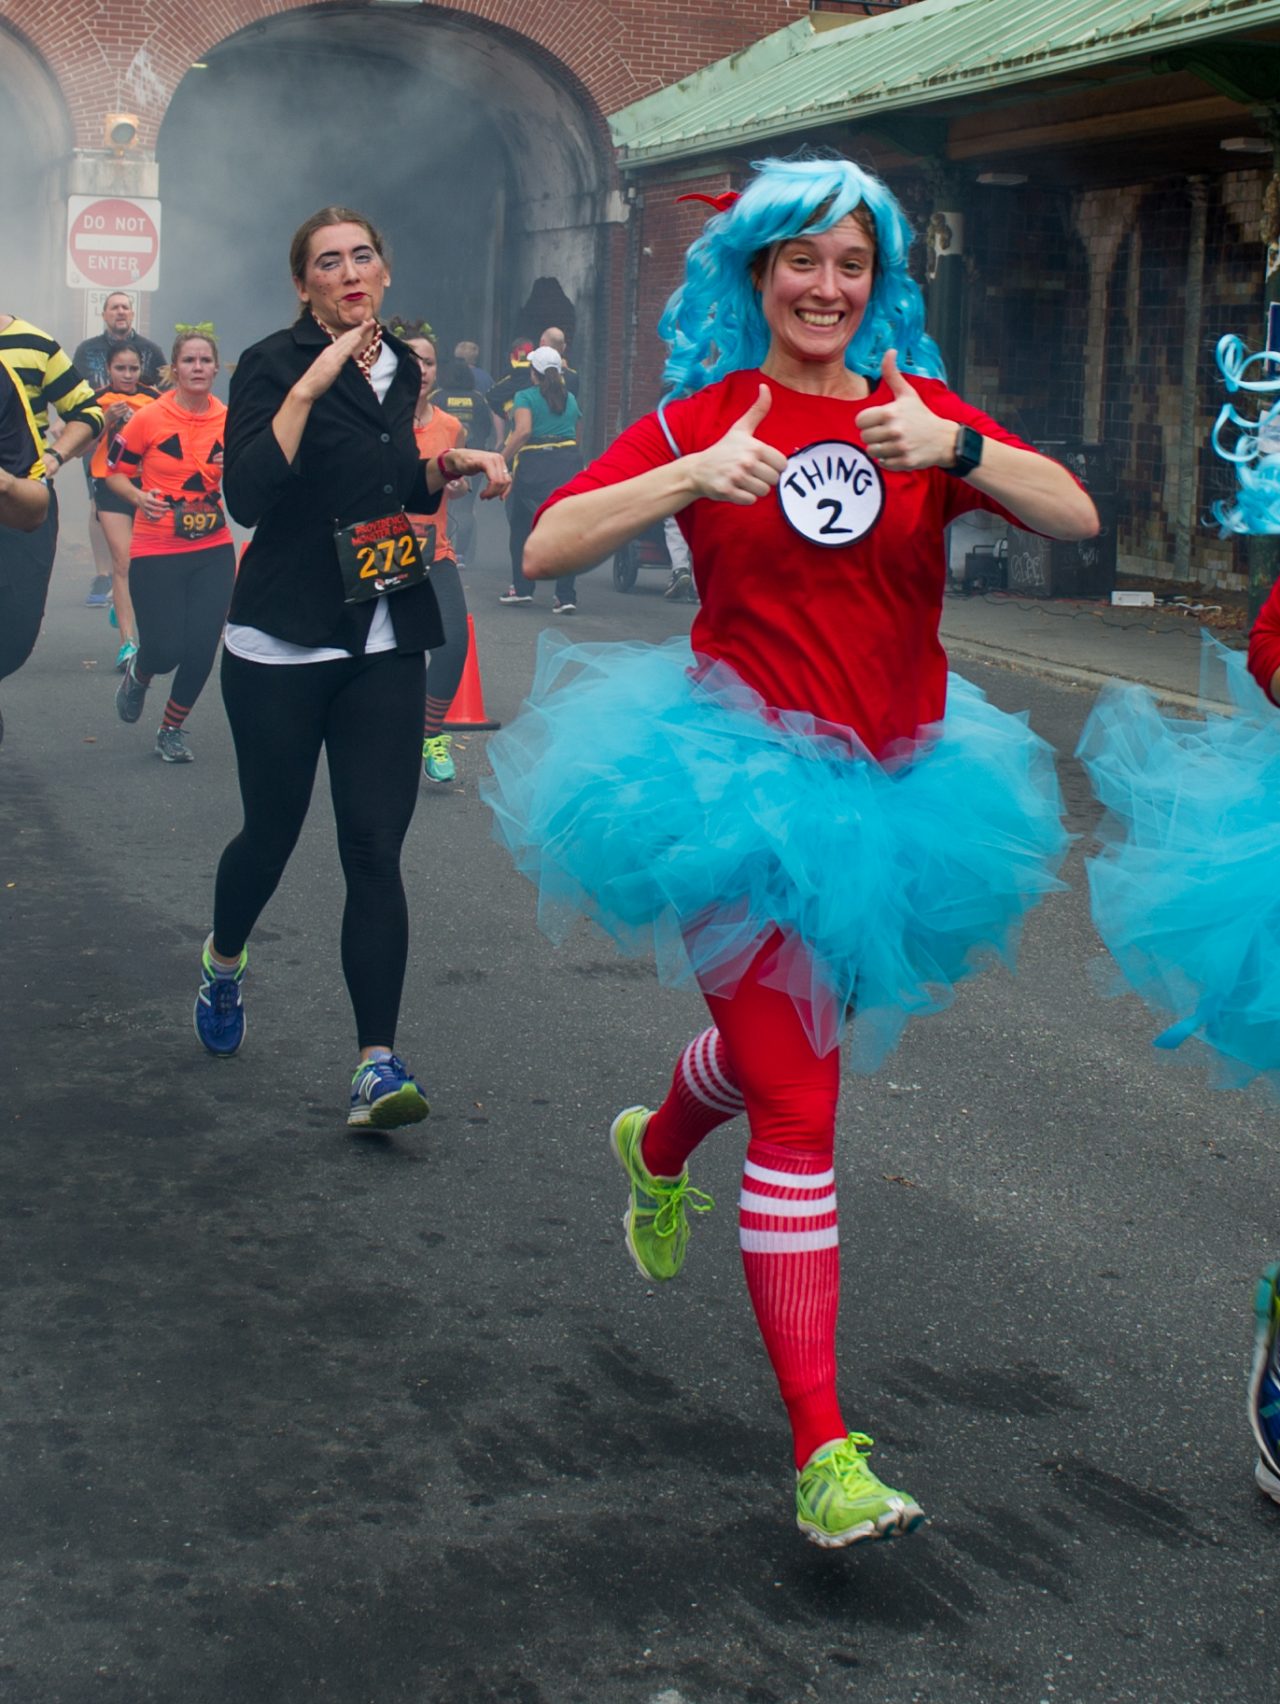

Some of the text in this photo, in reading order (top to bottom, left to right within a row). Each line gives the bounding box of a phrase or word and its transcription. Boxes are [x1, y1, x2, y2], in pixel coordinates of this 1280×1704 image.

[83, 215, 146, 232] DO NOT
[88, 255, 138, 270] ENTER
[783, 455, 873, 498] THING
[183, 513, 217, 531] 997
[816, 498, 853, 535] 2
[356, 535, 417, 579] 272
